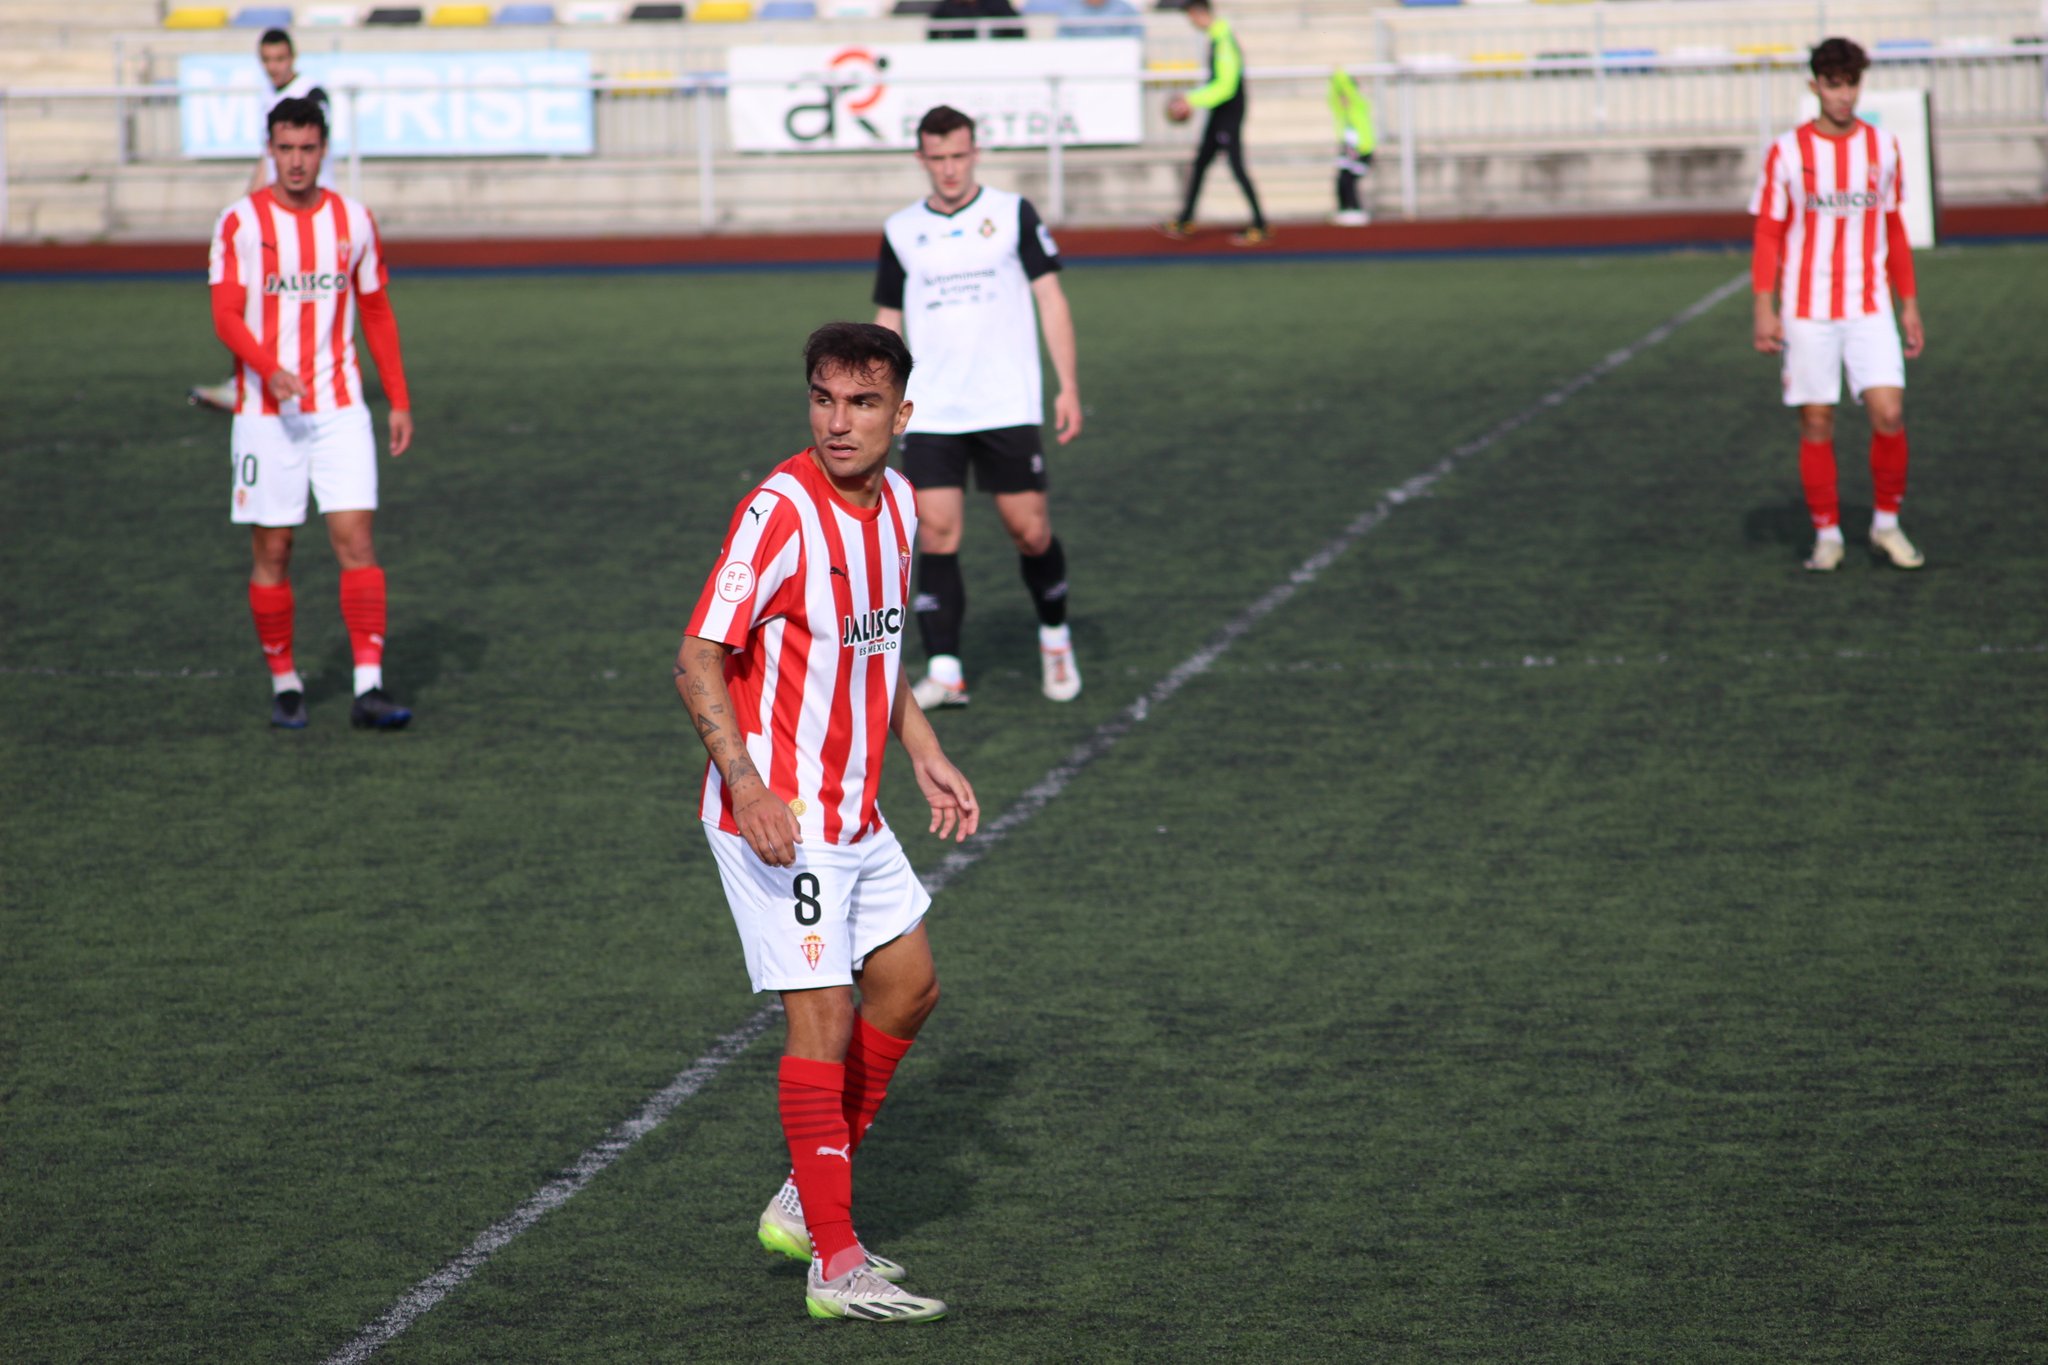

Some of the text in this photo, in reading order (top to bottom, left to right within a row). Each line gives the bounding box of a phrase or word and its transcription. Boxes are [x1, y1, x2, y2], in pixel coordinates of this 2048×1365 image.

[267, 273, 348, 292] JALISCO
[859, 647, 867, 656] ES
[793, 872, 821, 926] 8
